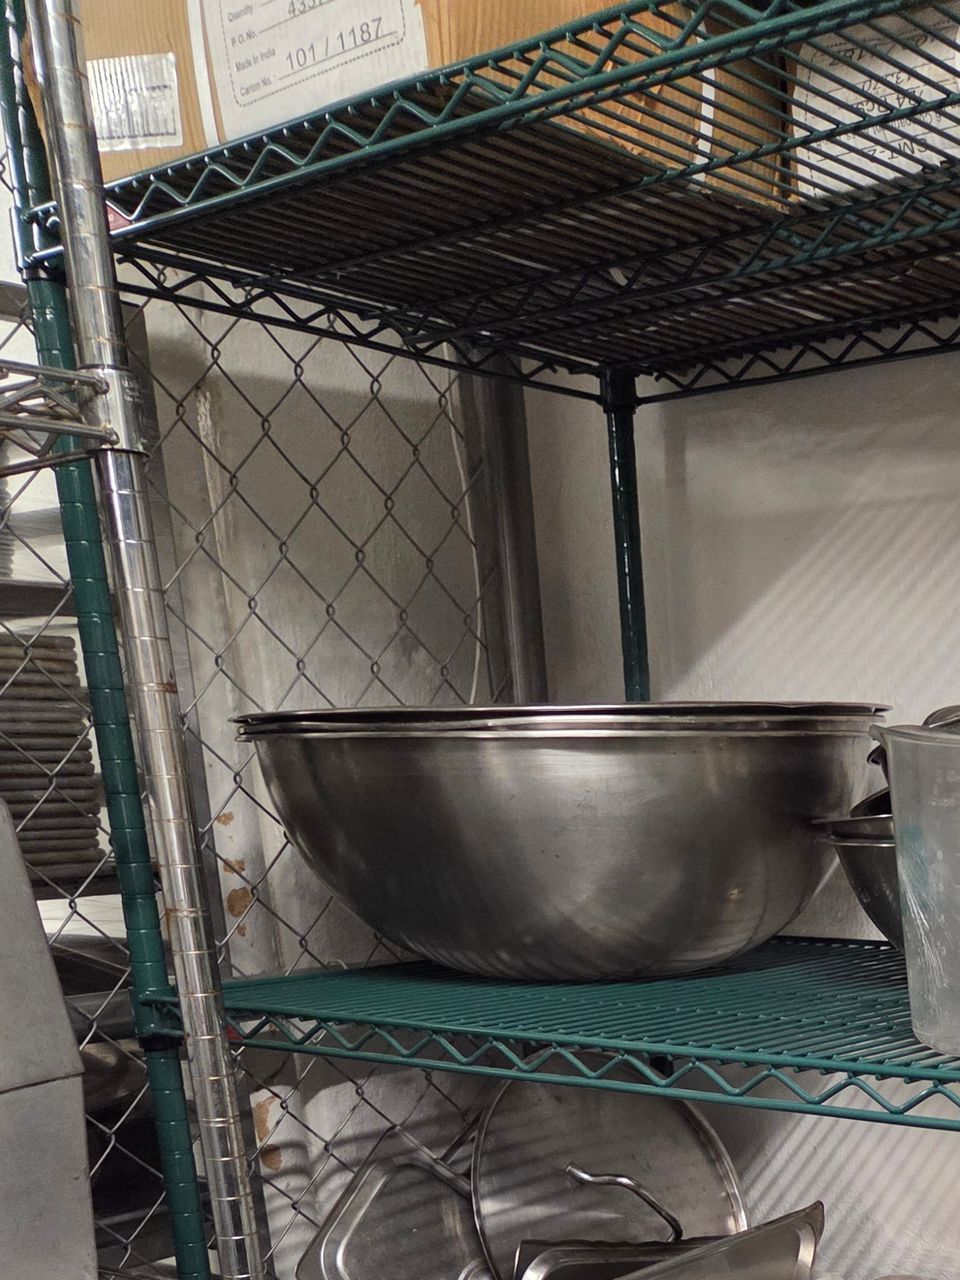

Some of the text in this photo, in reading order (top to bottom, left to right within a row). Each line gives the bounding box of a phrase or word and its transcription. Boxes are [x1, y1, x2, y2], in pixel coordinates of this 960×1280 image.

[286, 16, 384, 72] 101 / 1187
